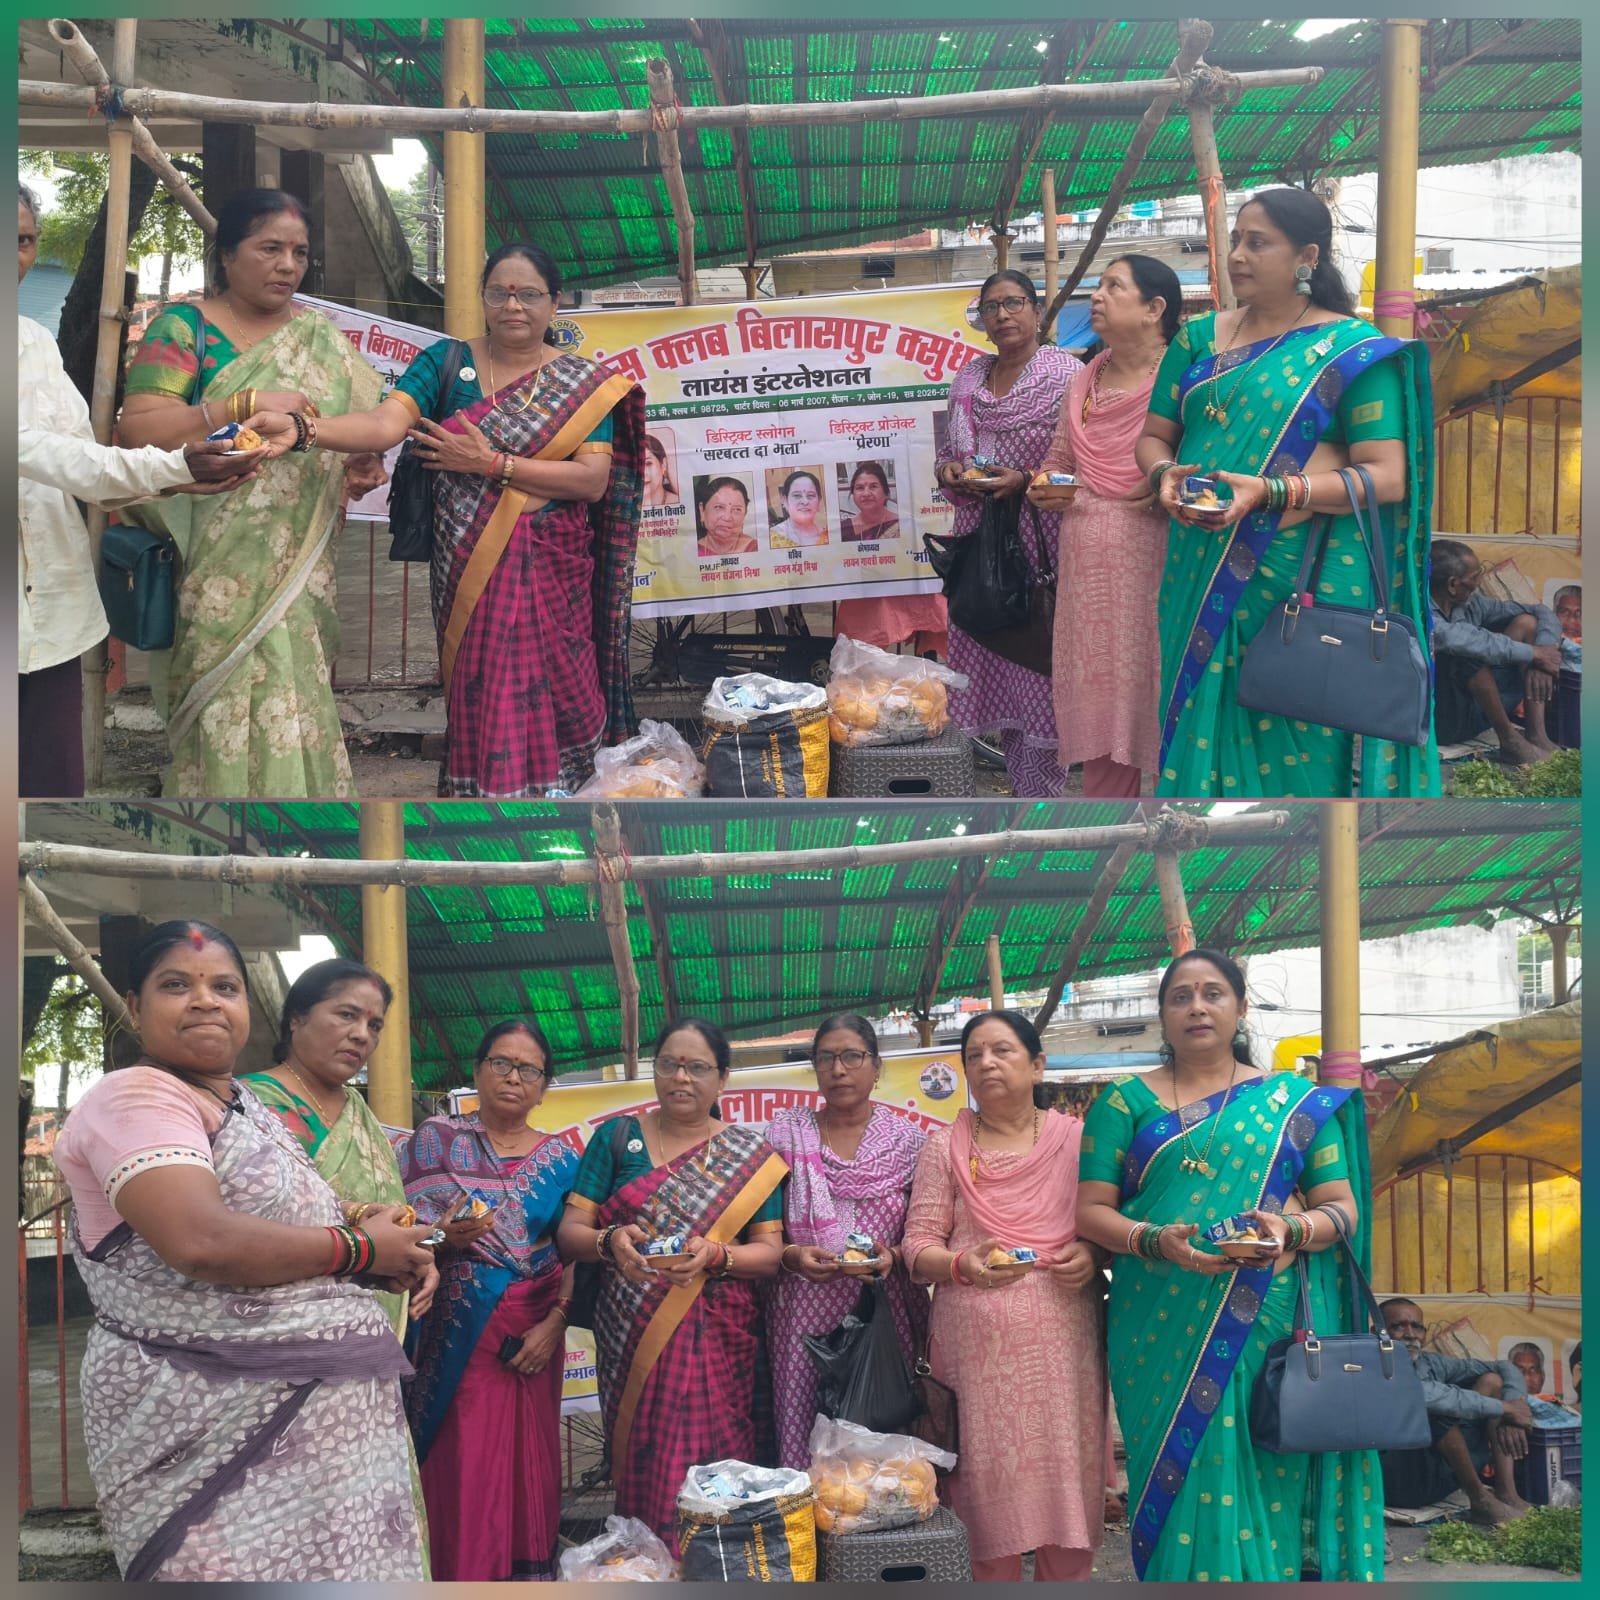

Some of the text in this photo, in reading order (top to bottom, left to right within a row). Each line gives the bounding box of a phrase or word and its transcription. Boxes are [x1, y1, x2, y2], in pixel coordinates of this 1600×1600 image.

[646, 323, 730, 369] क्लब
[736, 308, 892, 364] बिलासपुर
[896, 326, 988, 382] वसुंध
[681, 363, 871, 397] लायंस इंटरनेशनल
[829, 415, 916, 435] डिस्ट्रिक्ट प्रोजेक्ट
[705, 424, 795, 445] डिस्ट्रिक्ट स्लोगन
[754, 445, 768, 458] दा
[699, 563, 720, 572] PMJF
[774, 564, 790, 575] लायन
[701, 572, 720, 582] लायन
